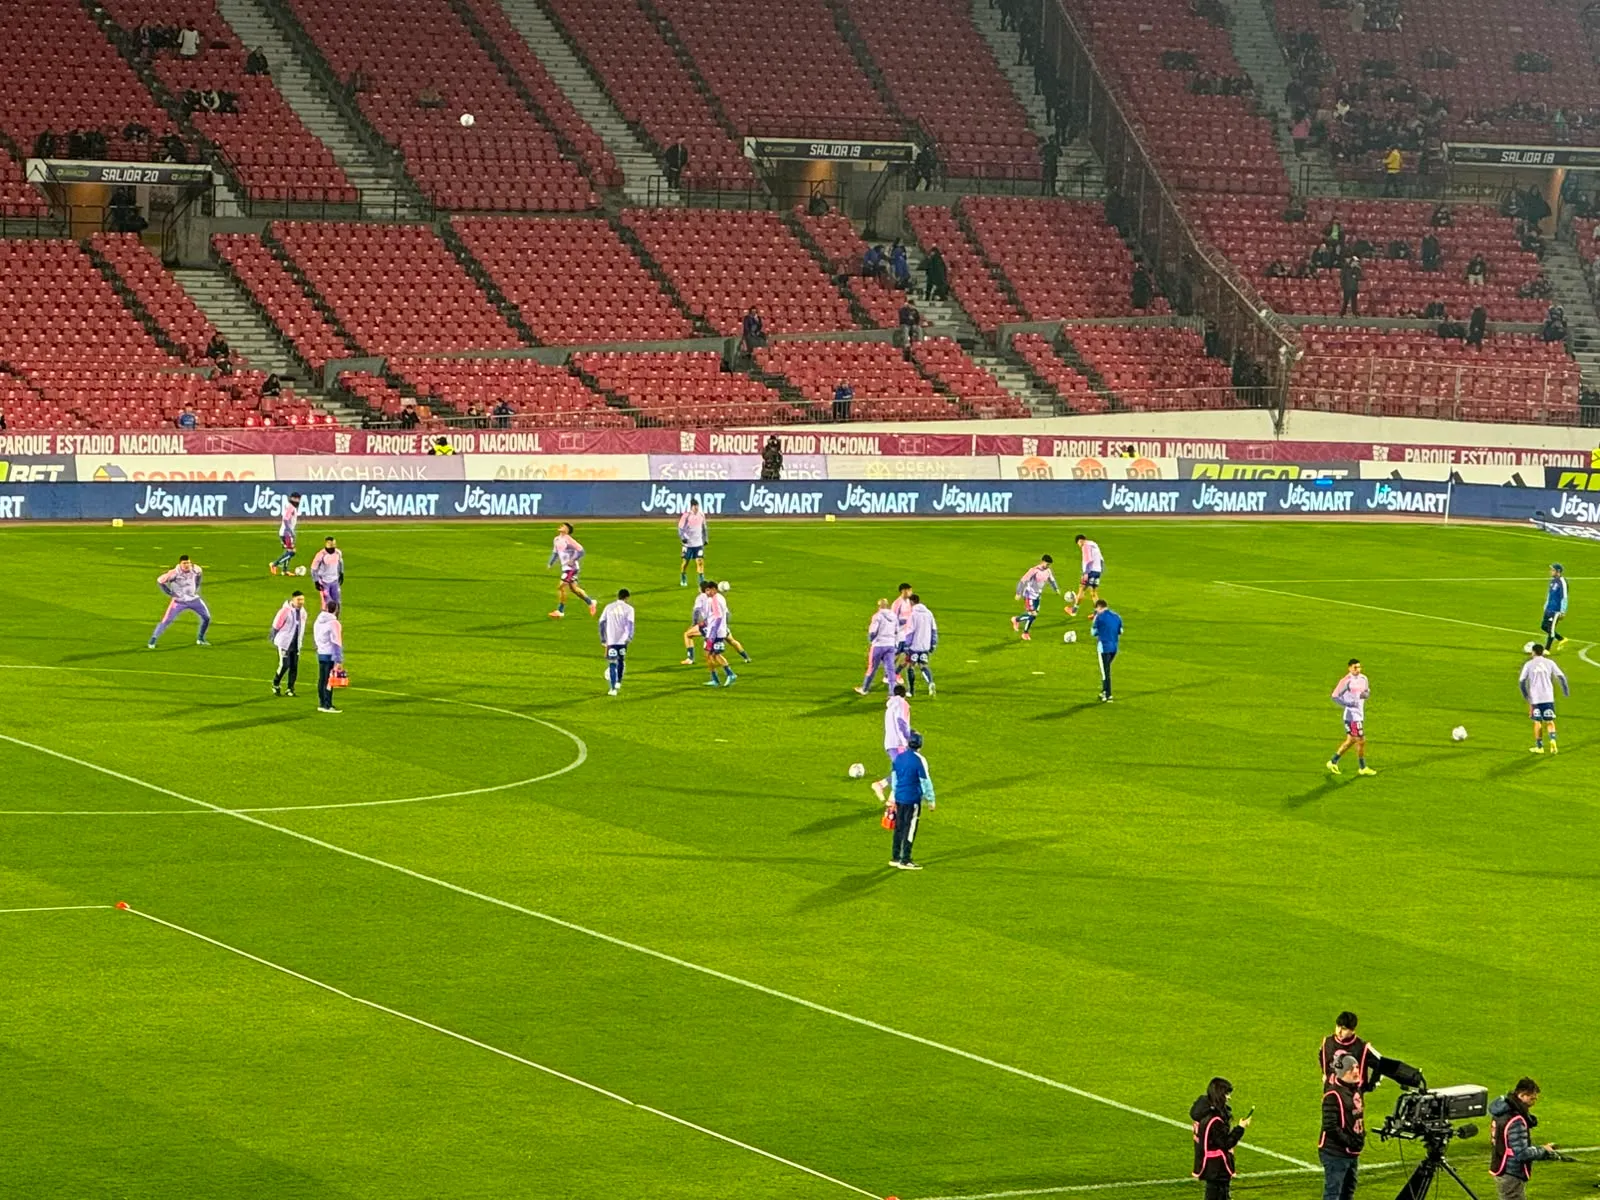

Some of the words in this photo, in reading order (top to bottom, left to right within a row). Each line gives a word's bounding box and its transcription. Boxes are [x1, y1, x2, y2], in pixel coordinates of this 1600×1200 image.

[810, 144, 848, 157] SALIDA
[849, 145, 861, 157] 19
[1501, 151, 1541, 163] SALIDA
[1542, 152, 1555, 164] 18
[101, 168, 142, 182] SALIDA
[143, 169, 159, 183] 20
[0, 435, 51, 456] PARQUE
[56, 435, 114, 455] ESTADIO
[119, 435, 188, 454] NACIONAL
[366, 435, 417, 455] PARQUE
[479, 433, 542, 453] NACIONAL
[709, 435, 758, 455] PARQUE
[819, 436, 882, 455] NACIONAL
[1053, 440, 1103, 457] PARQUE
[1165, 442, 1229, 460] NACIONAL
[895, 461, 945, 472] OCEAN
[1404, 449, 1455, 464] PARQUE
[1460, 450, 1517, 466] ESTADIO
[1521, 453, 1585, 468] NACIONAL
[307, 466, 428, 480] MACHBANK
[135, 485, 228, 517] JetSMART
[350, 484, 439, 516] JetSMART
[454, 484, 542, 515] JetSMART
[740, 483, 823, 514] JetSMART
[837, 483, 919, 514] JetSMART
[932, 483, 1013, 513] JetSMART
[1102, 483, 1179, 512] JetSMART
[1192, 482, 1267, 512] JetSMART
[1279, 482, 1354, 512] JetSMART
[1366, 482, 1447, 513] JetSMART
